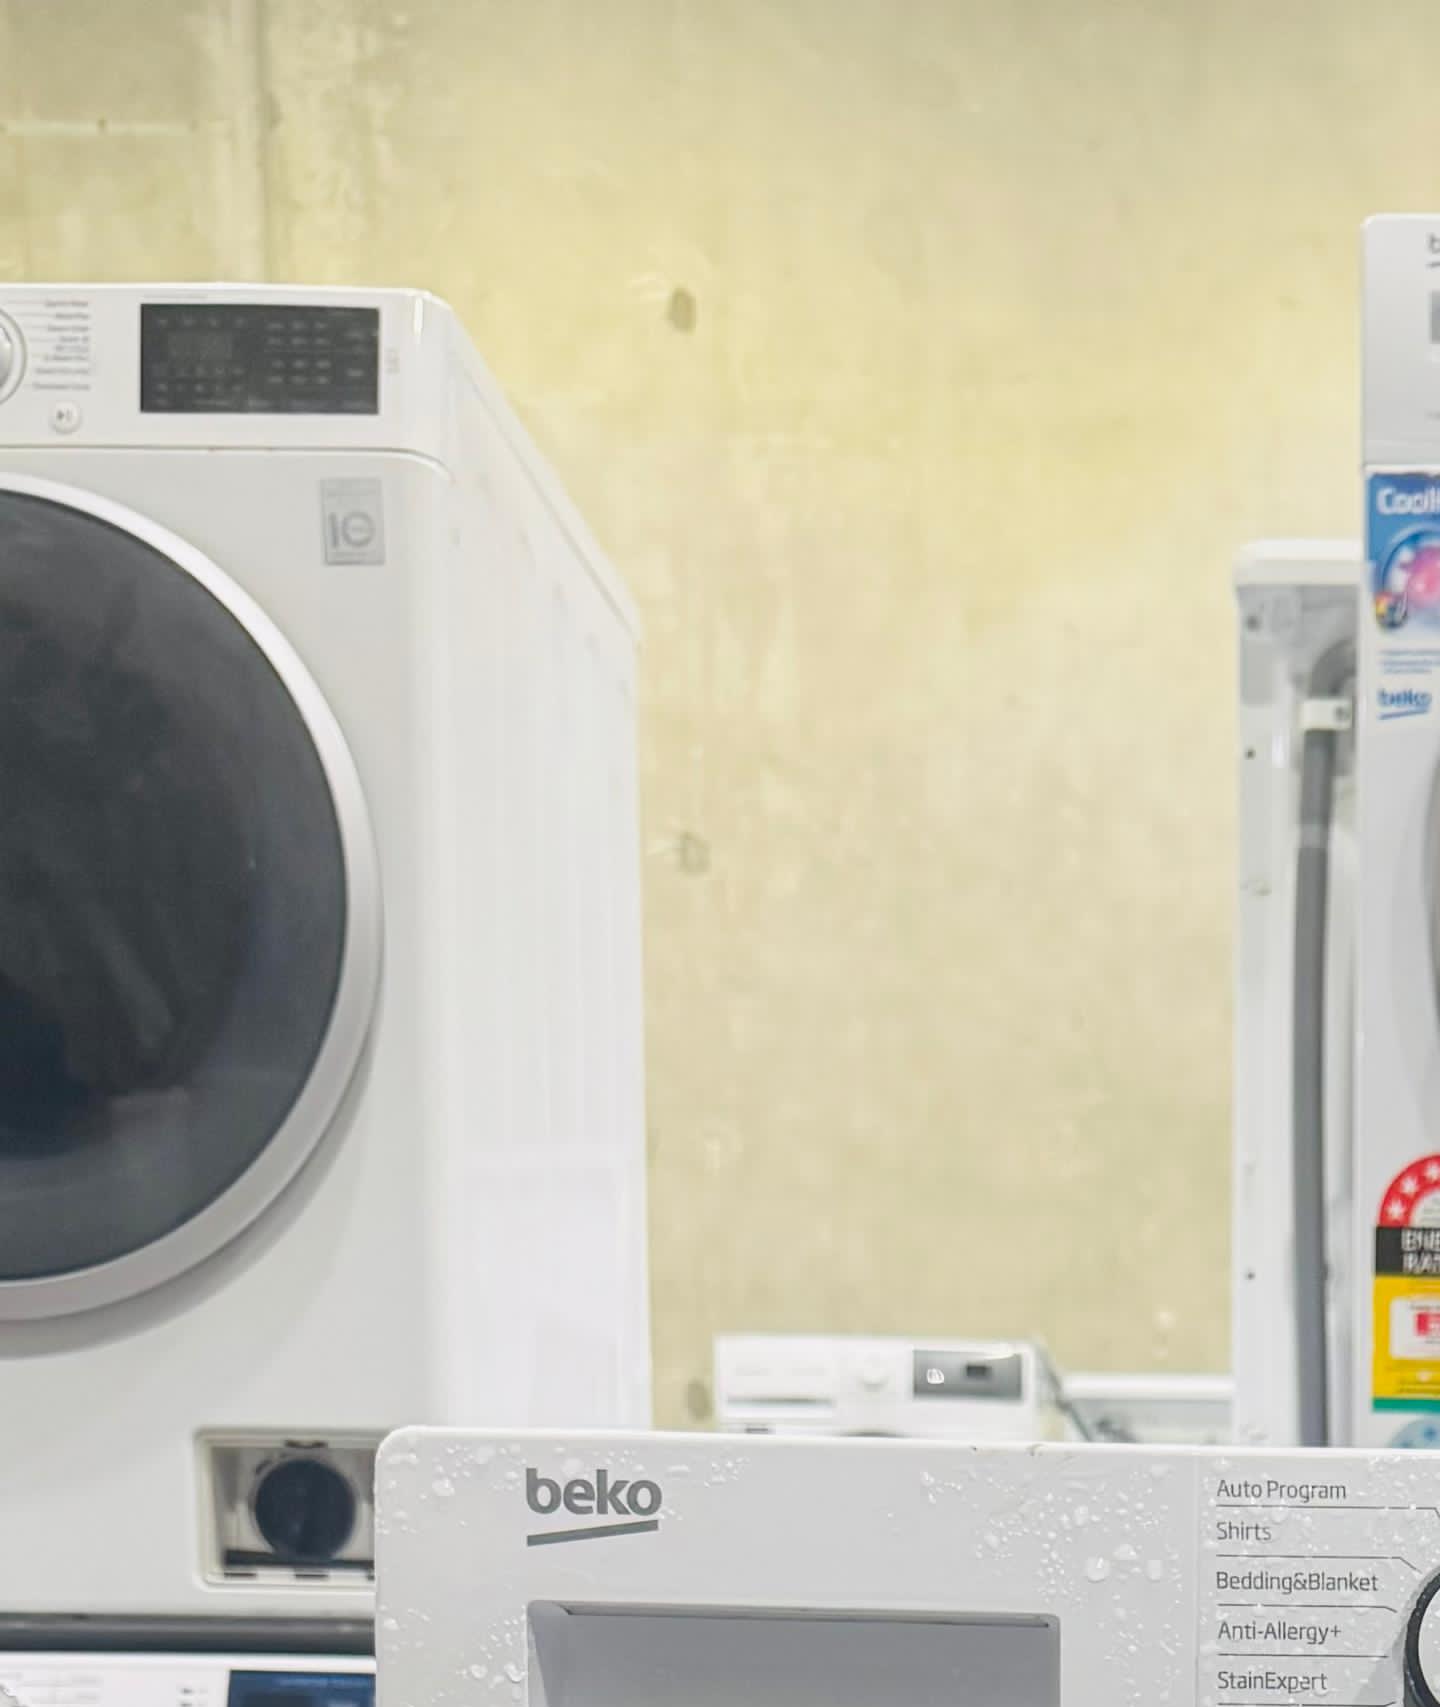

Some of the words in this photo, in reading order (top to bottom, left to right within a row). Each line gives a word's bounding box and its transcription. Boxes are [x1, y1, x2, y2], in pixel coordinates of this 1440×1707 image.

[525, 1467, 663, 1517] beko
[1217, 1479, 1262, 1499] Auto
[1267, 1480, 1346, 1503] Program
[1217, 1521, 1272, 1541] Shirts
[1216, 1571, 1378, 1595] Bedding&Blanket
[1218, 1621, 1341, 1645] Anti-Allergy+
[1217, 1671, 1328, 1694] StainExpert
